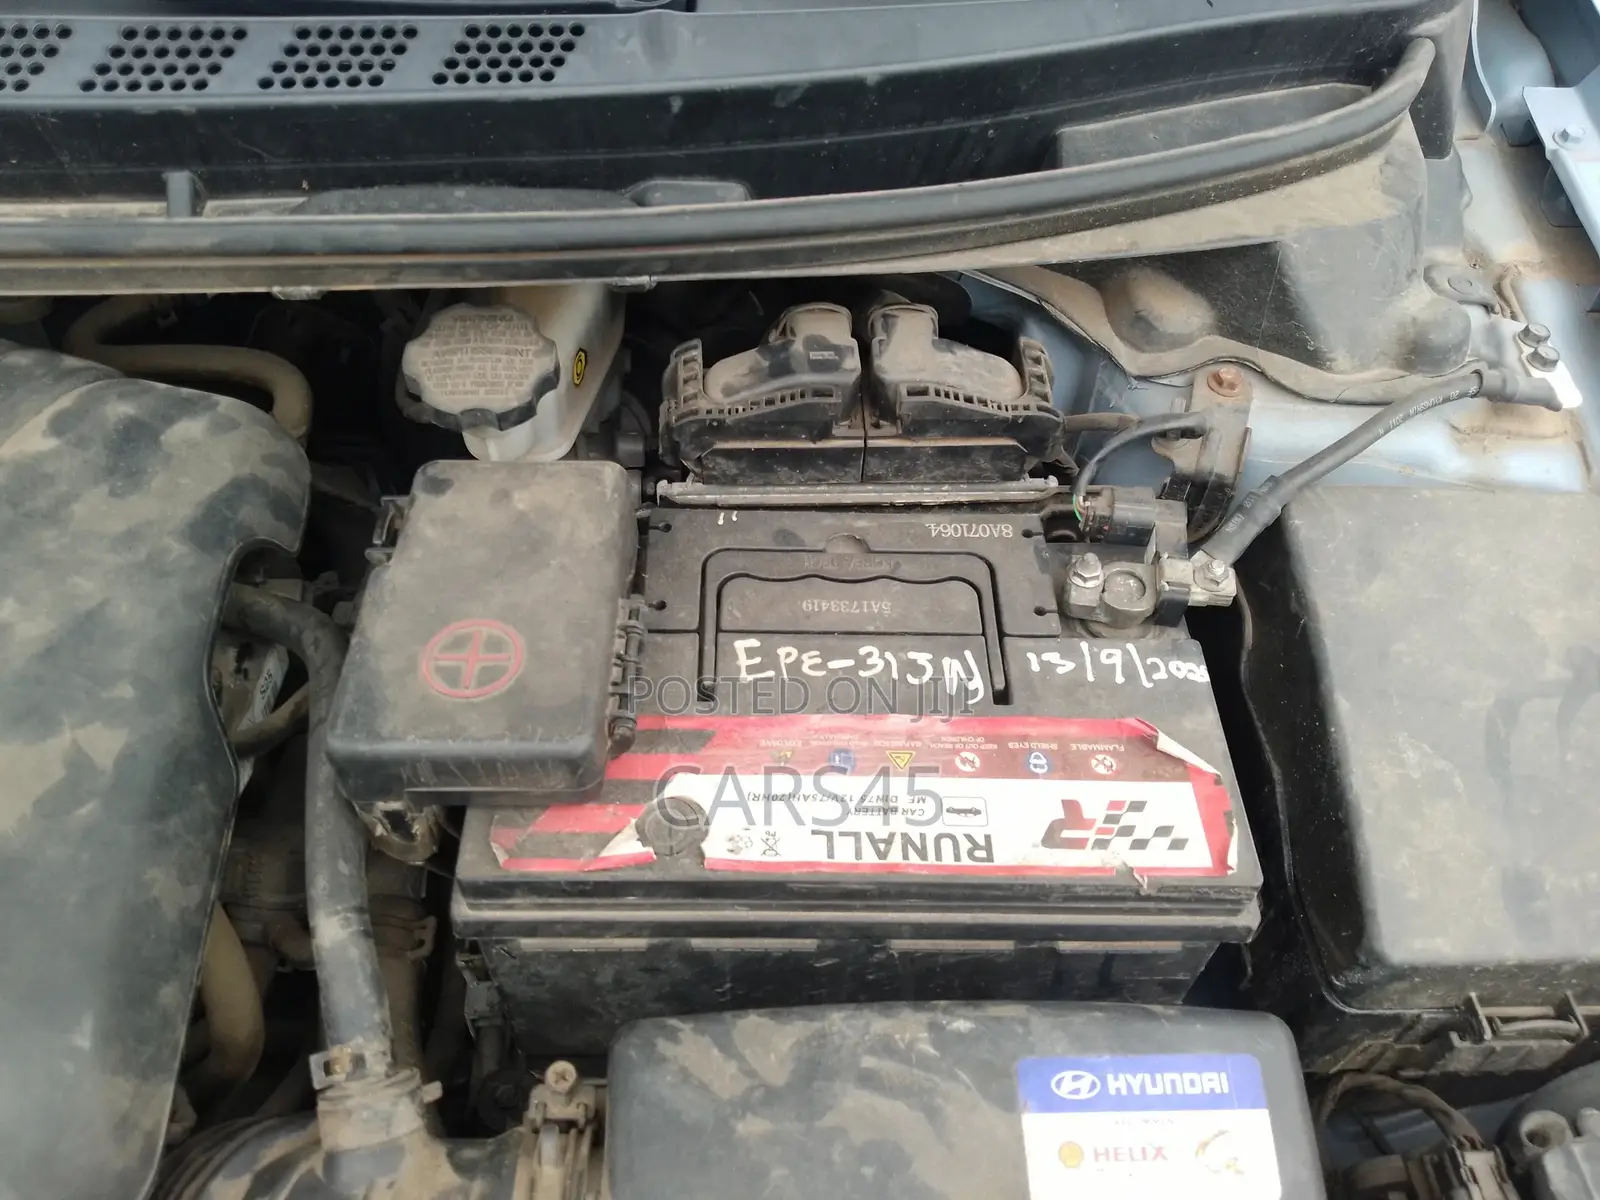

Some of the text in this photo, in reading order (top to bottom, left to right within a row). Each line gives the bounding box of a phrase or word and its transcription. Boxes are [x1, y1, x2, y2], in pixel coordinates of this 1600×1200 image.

[1069, 743, 1125, 752] FLAMMABLE
[846, 806, 926, 817] CAR BATTERY
[811, 828, 995, 864] RUNALL
[1106, 1072, 1229, 1096] HYUNDAI
[1093, 1146, 1169, 1163] HELIX
